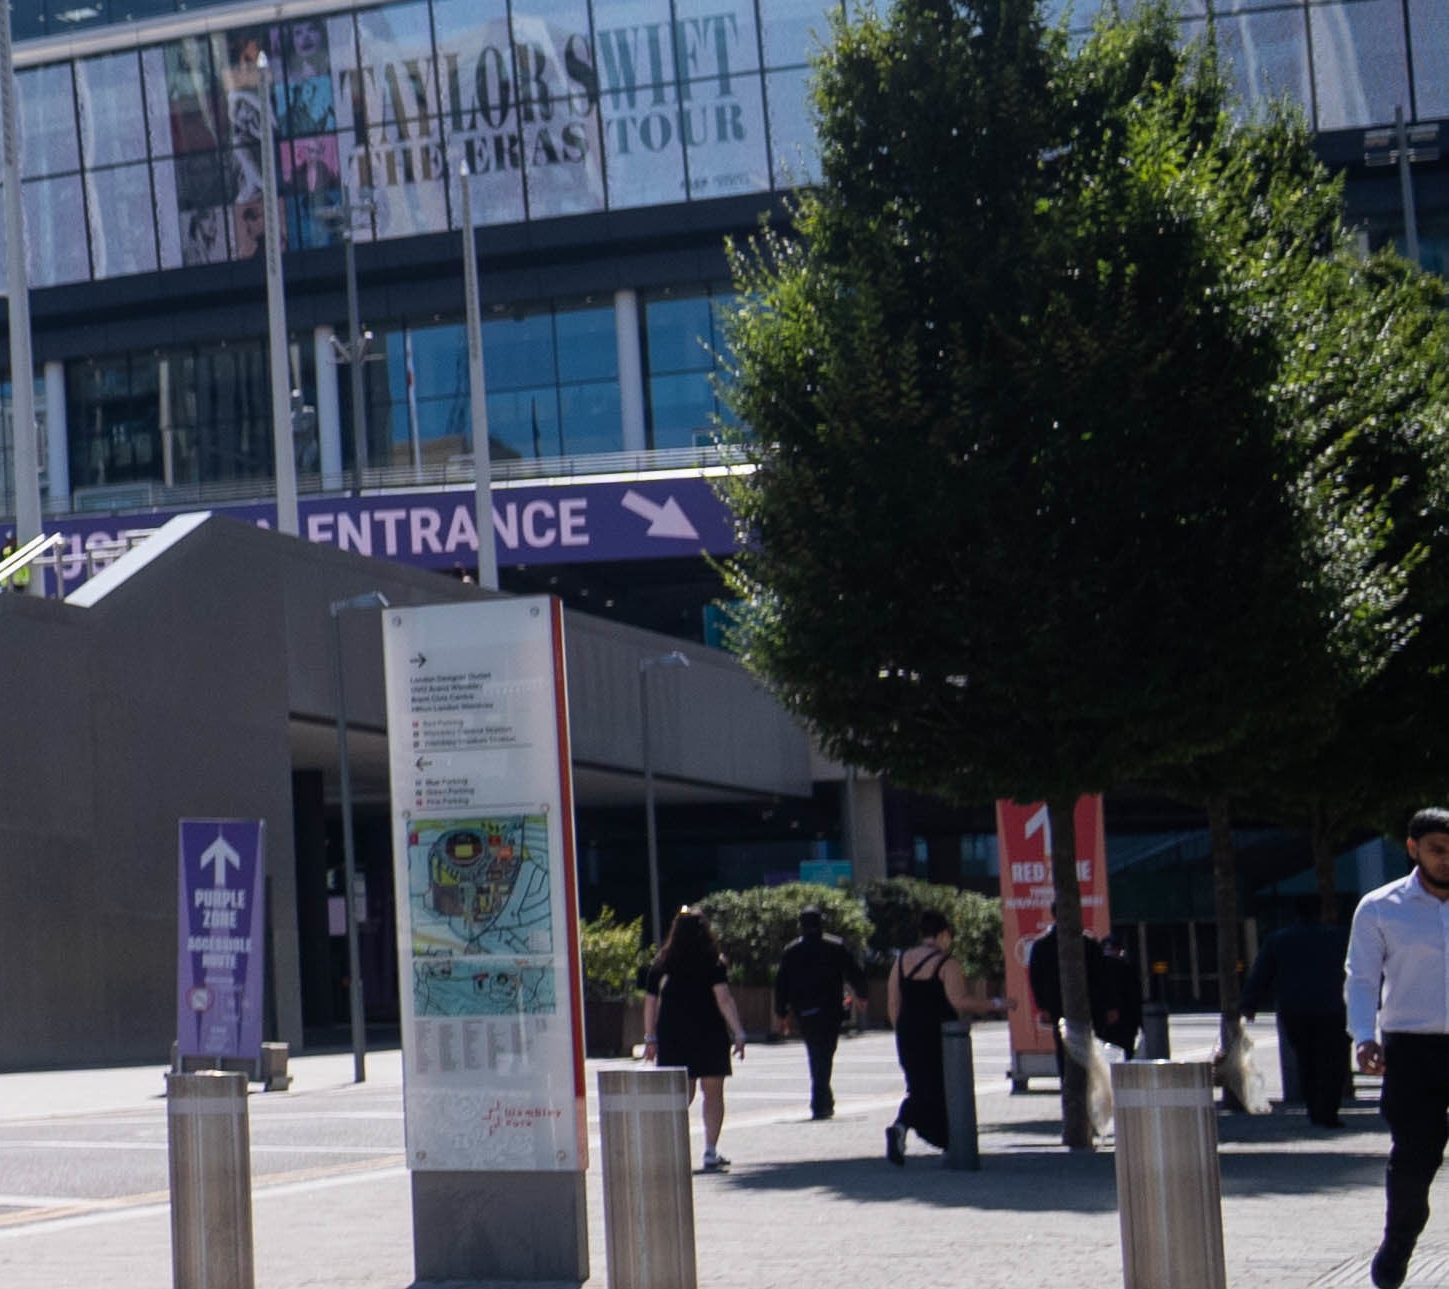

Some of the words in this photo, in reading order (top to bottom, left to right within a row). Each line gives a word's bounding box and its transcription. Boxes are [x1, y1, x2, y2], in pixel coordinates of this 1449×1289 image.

[338, 42, 554, 146] TAYLOR
[563, 12, 739, 119] SWIFT
[349, 141, 446, 189] THE
[463, 122, 590, 177] ERAS
[605, 102, 748, 156] TOUR
[307, 497, 590, 557] ENTRANCE
[1011, 861, 1045, 884] RED
[194, 888, 247, 911] PURPLE
[202, 909, 237, 930] ZONE
